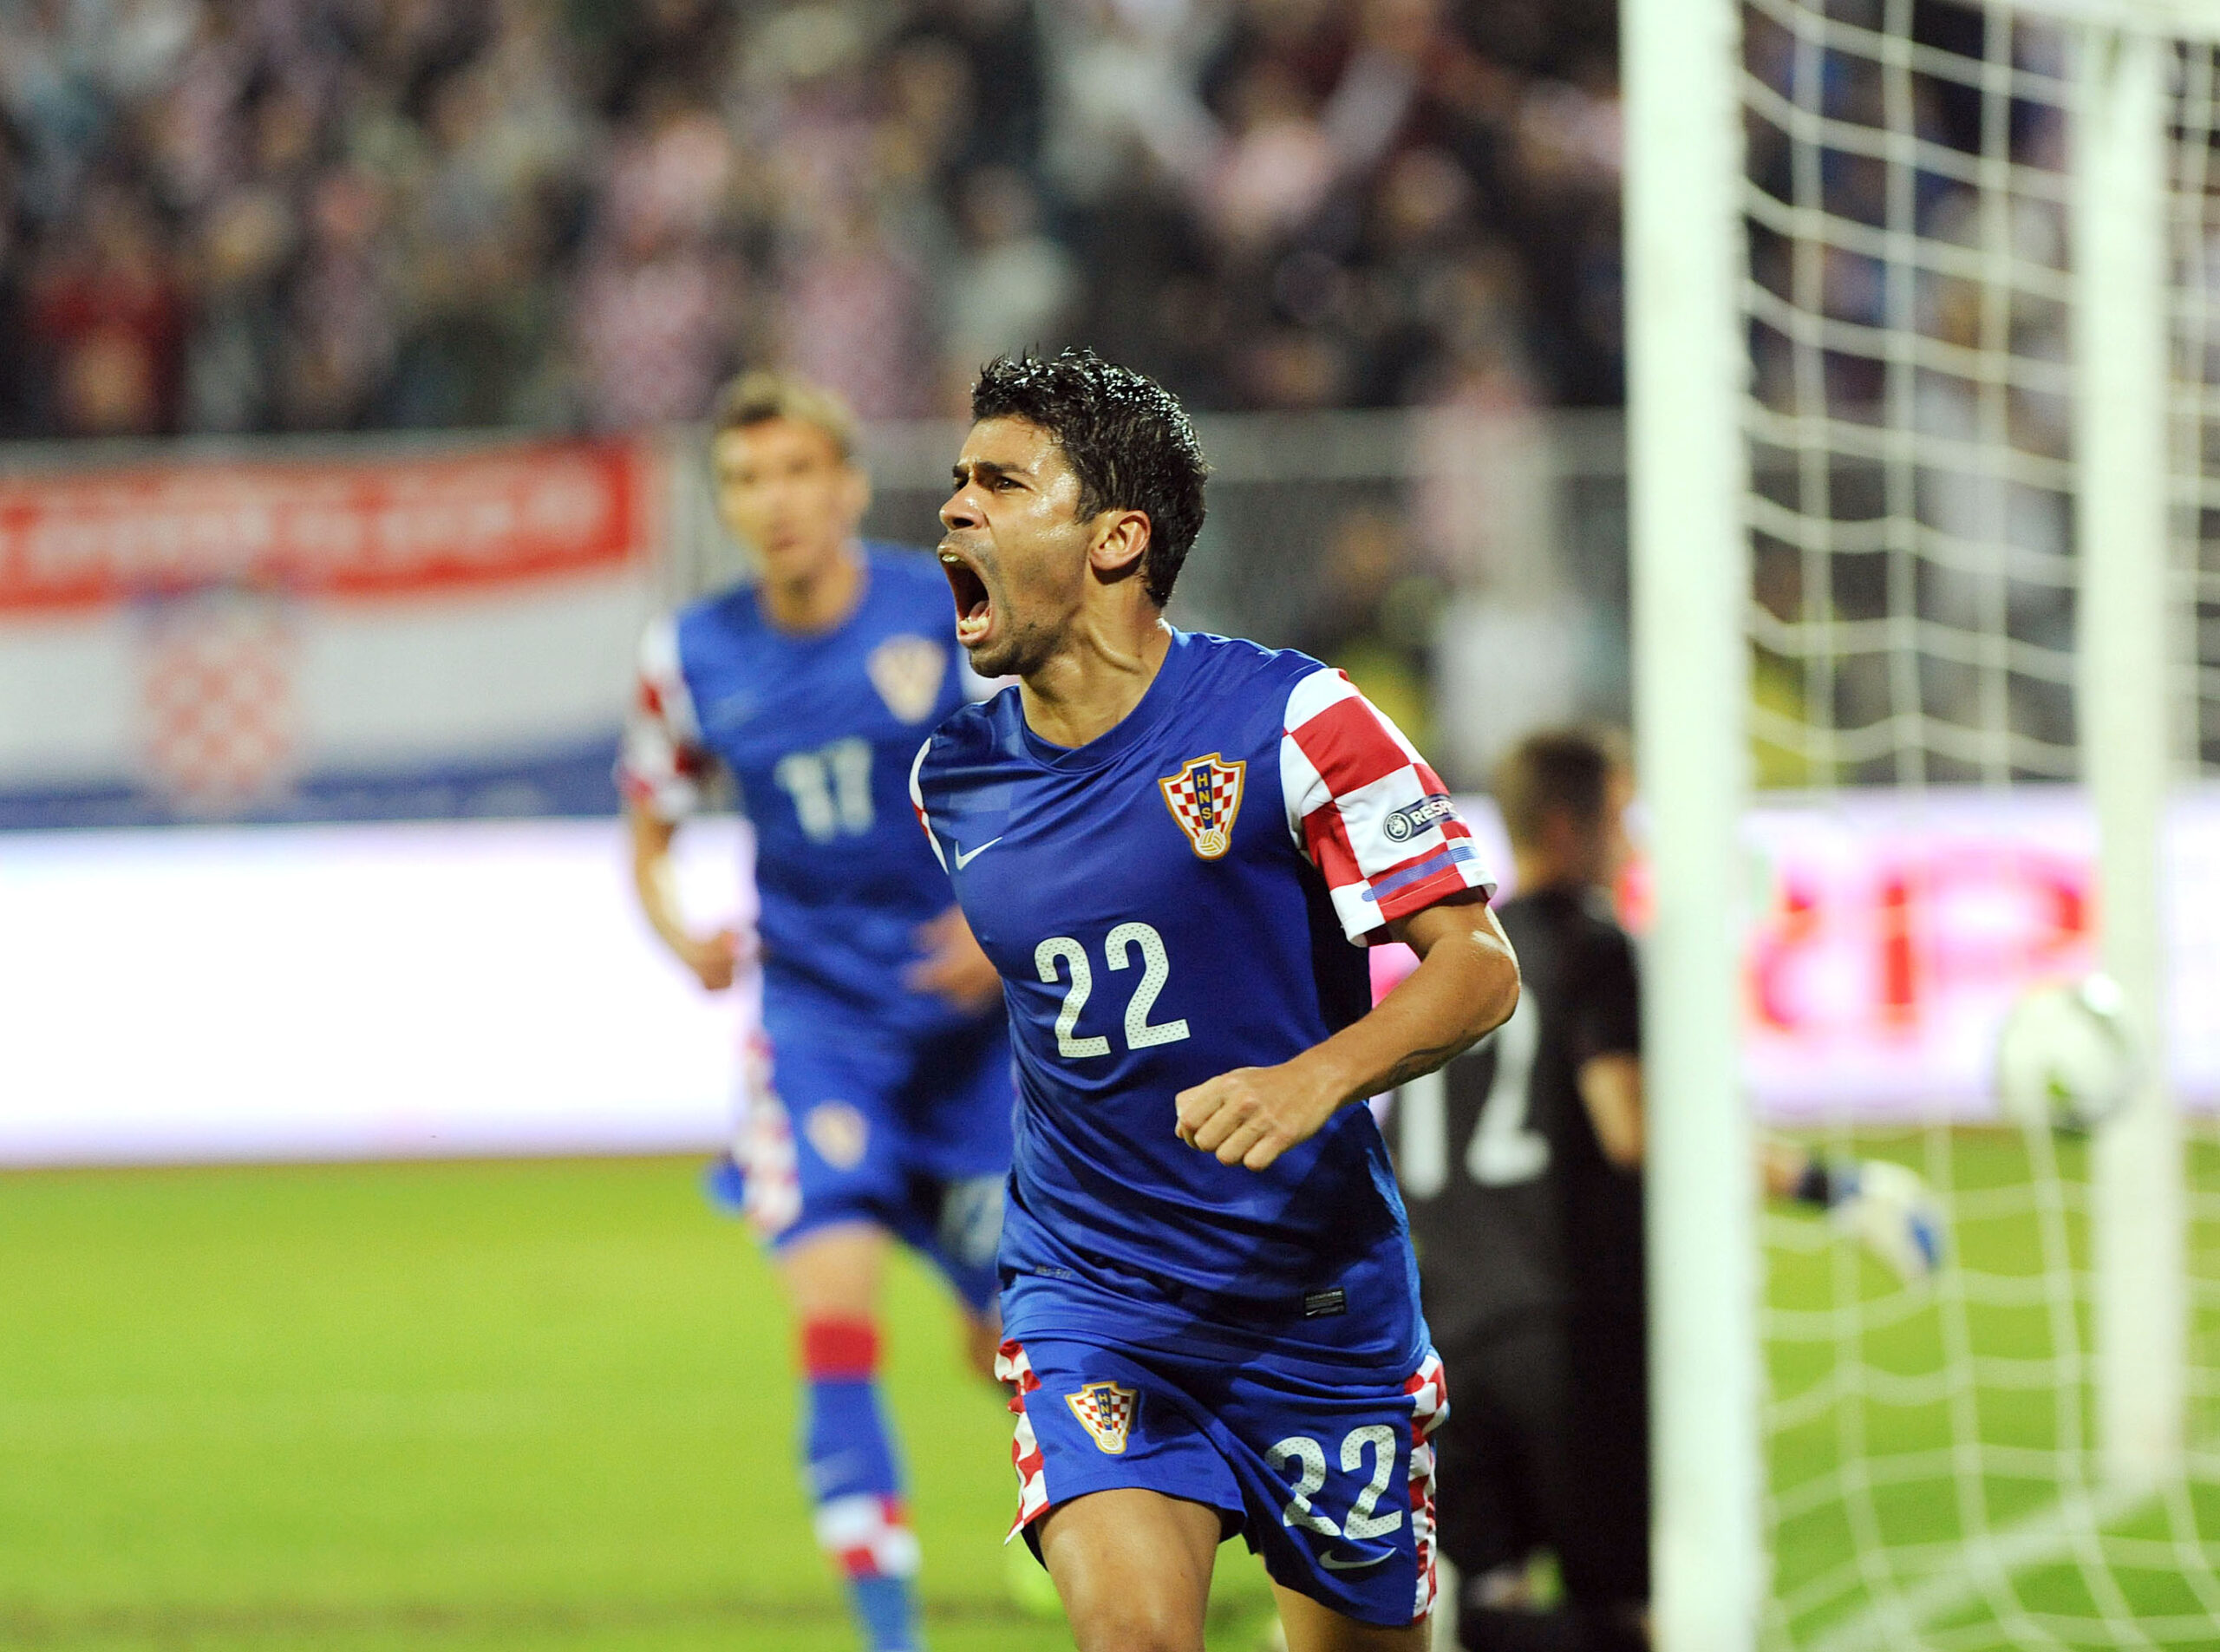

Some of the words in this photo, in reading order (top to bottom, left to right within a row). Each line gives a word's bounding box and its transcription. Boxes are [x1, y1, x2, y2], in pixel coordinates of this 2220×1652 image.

[1196, 772, 1212, 820] HNS
[1035, 922, 1191, 1058] 22
[1097, 1392, 1111, 1426] HNS
[1264, 1424, 1402, 1540] 22
